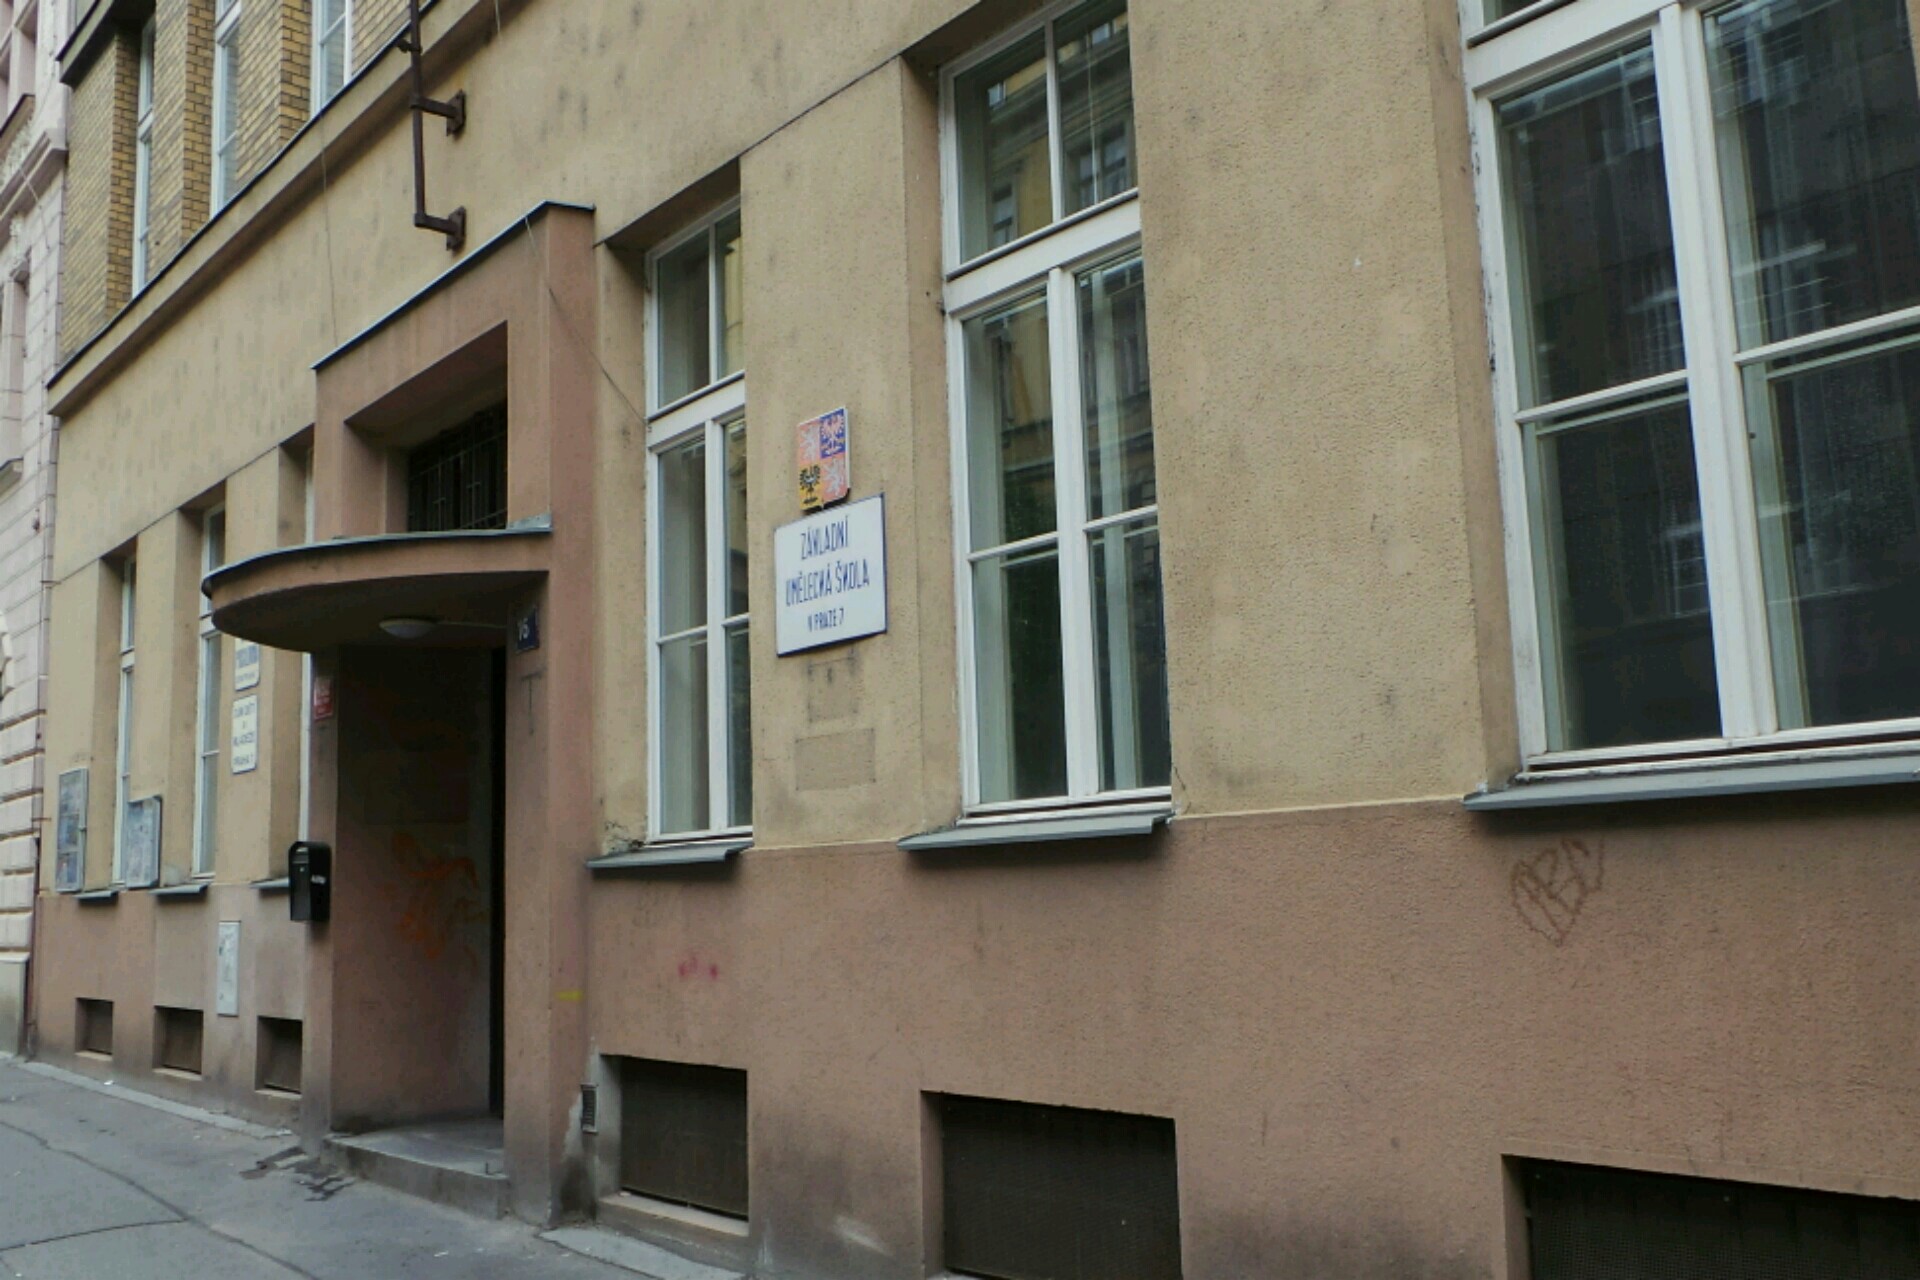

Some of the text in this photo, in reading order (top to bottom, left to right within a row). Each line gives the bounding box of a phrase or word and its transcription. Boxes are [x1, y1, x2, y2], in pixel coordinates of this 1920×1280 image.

[801, 515, 848, 560] ZÁKLADNÍ
[786, 559, 870, 607] UMĚLECKÁ ŠKOLA
[814, 610, 837, 630] PRAZE
[839, 607, 845, 625] 7
